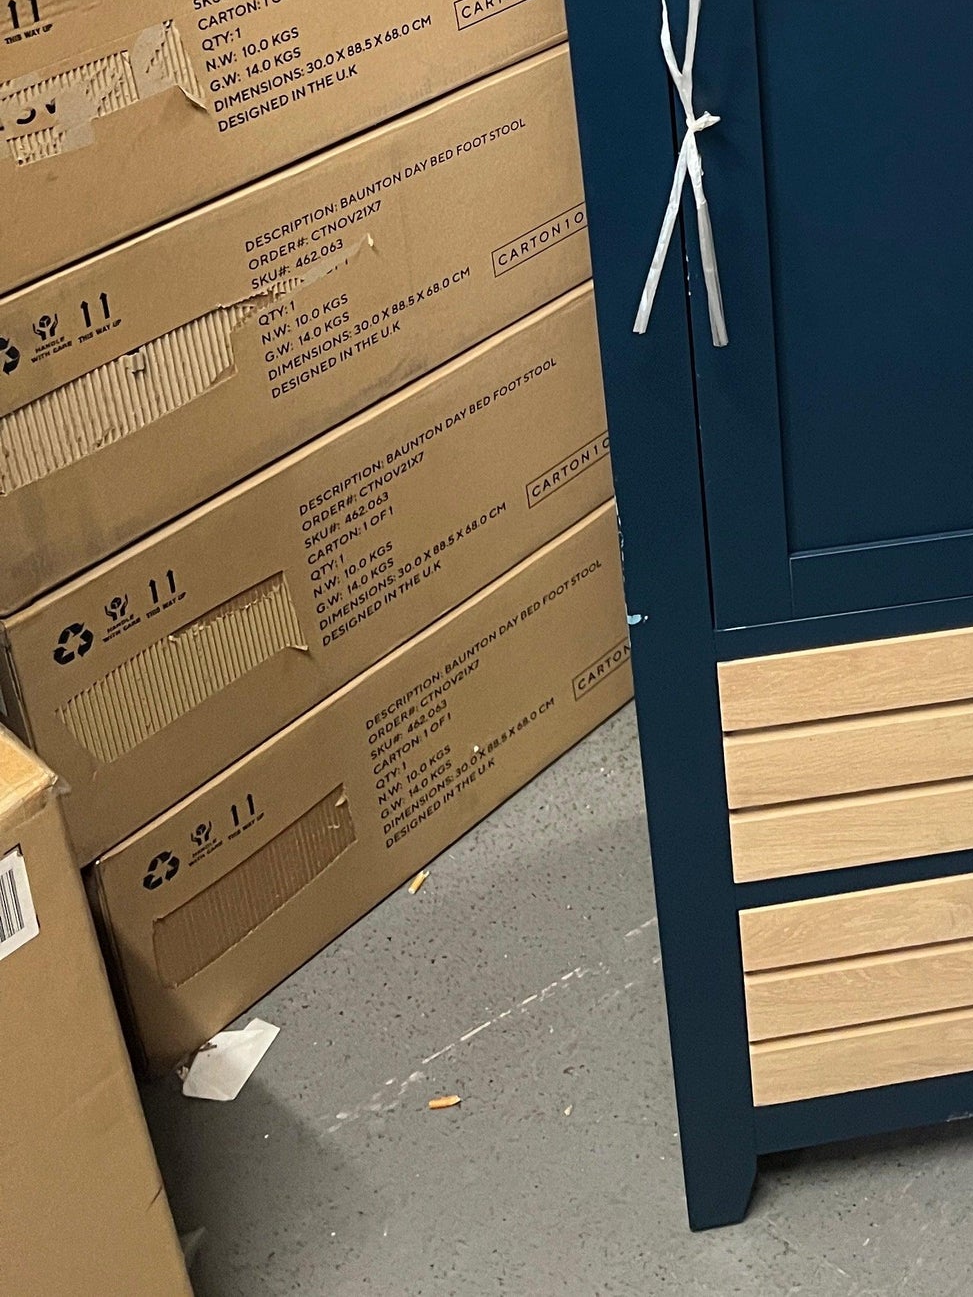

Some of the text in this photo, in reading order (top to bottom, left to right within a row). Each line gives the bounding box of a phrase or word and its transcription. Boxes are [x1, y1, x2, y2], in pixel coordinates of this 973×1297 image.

[23, 28, 41, 39] WAY
[340, 171, 402, 209] BAUNTON
[404, 159, 428, 178] DAY
[430, 149, 453, 167] BED
[456, 133, 488, 156] FOOT
[489, 118, 526, 141] STOOL
[498, 223, 561, 266] CARTON
[386, 423, 443, 464] BAUNTON
[493, 376, 522, 401] FOOT
[523, 358, 557, 383] STOOL
[531, 450, 590, 497] CARTON
